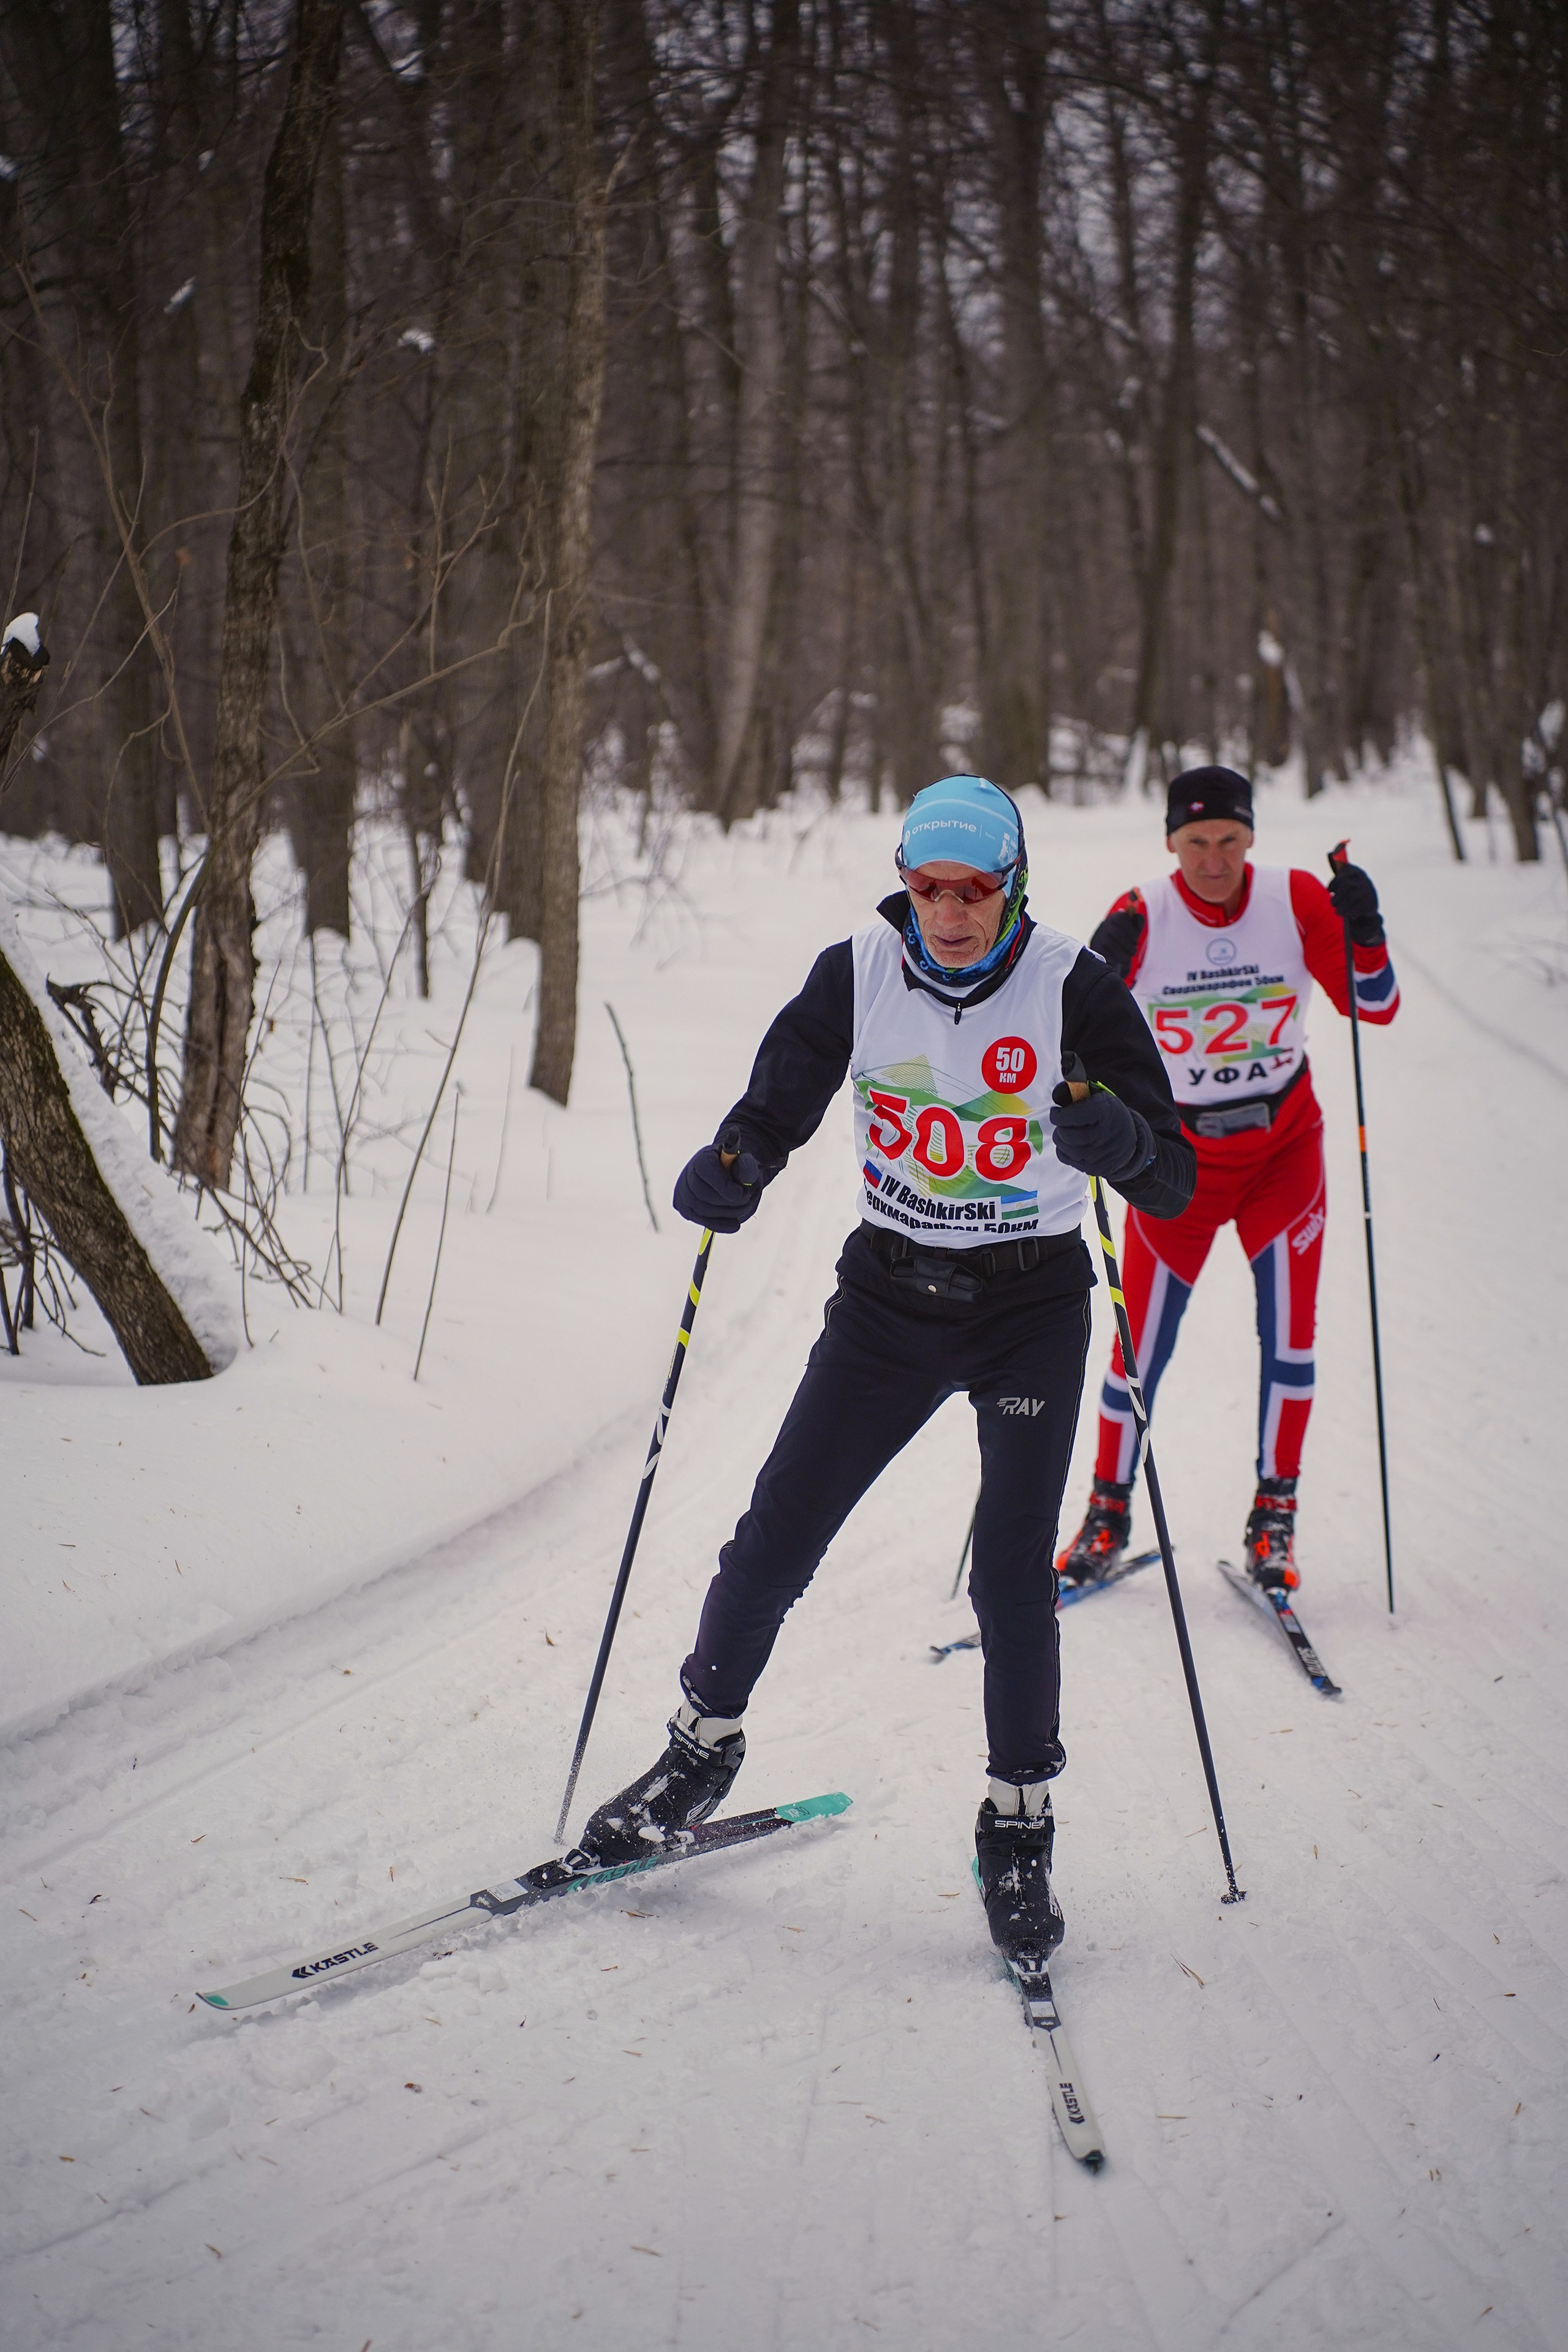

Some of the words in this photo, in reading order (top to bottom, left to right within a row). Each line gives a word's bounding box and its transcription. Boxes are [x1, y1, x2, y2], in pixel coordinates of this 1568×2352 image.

[911, 820, 977, 834] открытие
[1155, 995, 1297, 1055] 527
[996, 1047, 1025, 1072] 50
[1188, 1062, 1267, 1085] УФА
[868, 1089, 1032, 1181] 508
[880, 1174, 902, 1198] IV
[896, 1185, 996, 1220] BashkirSki
[997, 1397, 1046, 1417] RAY
[674, 1730, 709, 1760] SPINE
[994, 1820, 1042, 1830] SPINE
